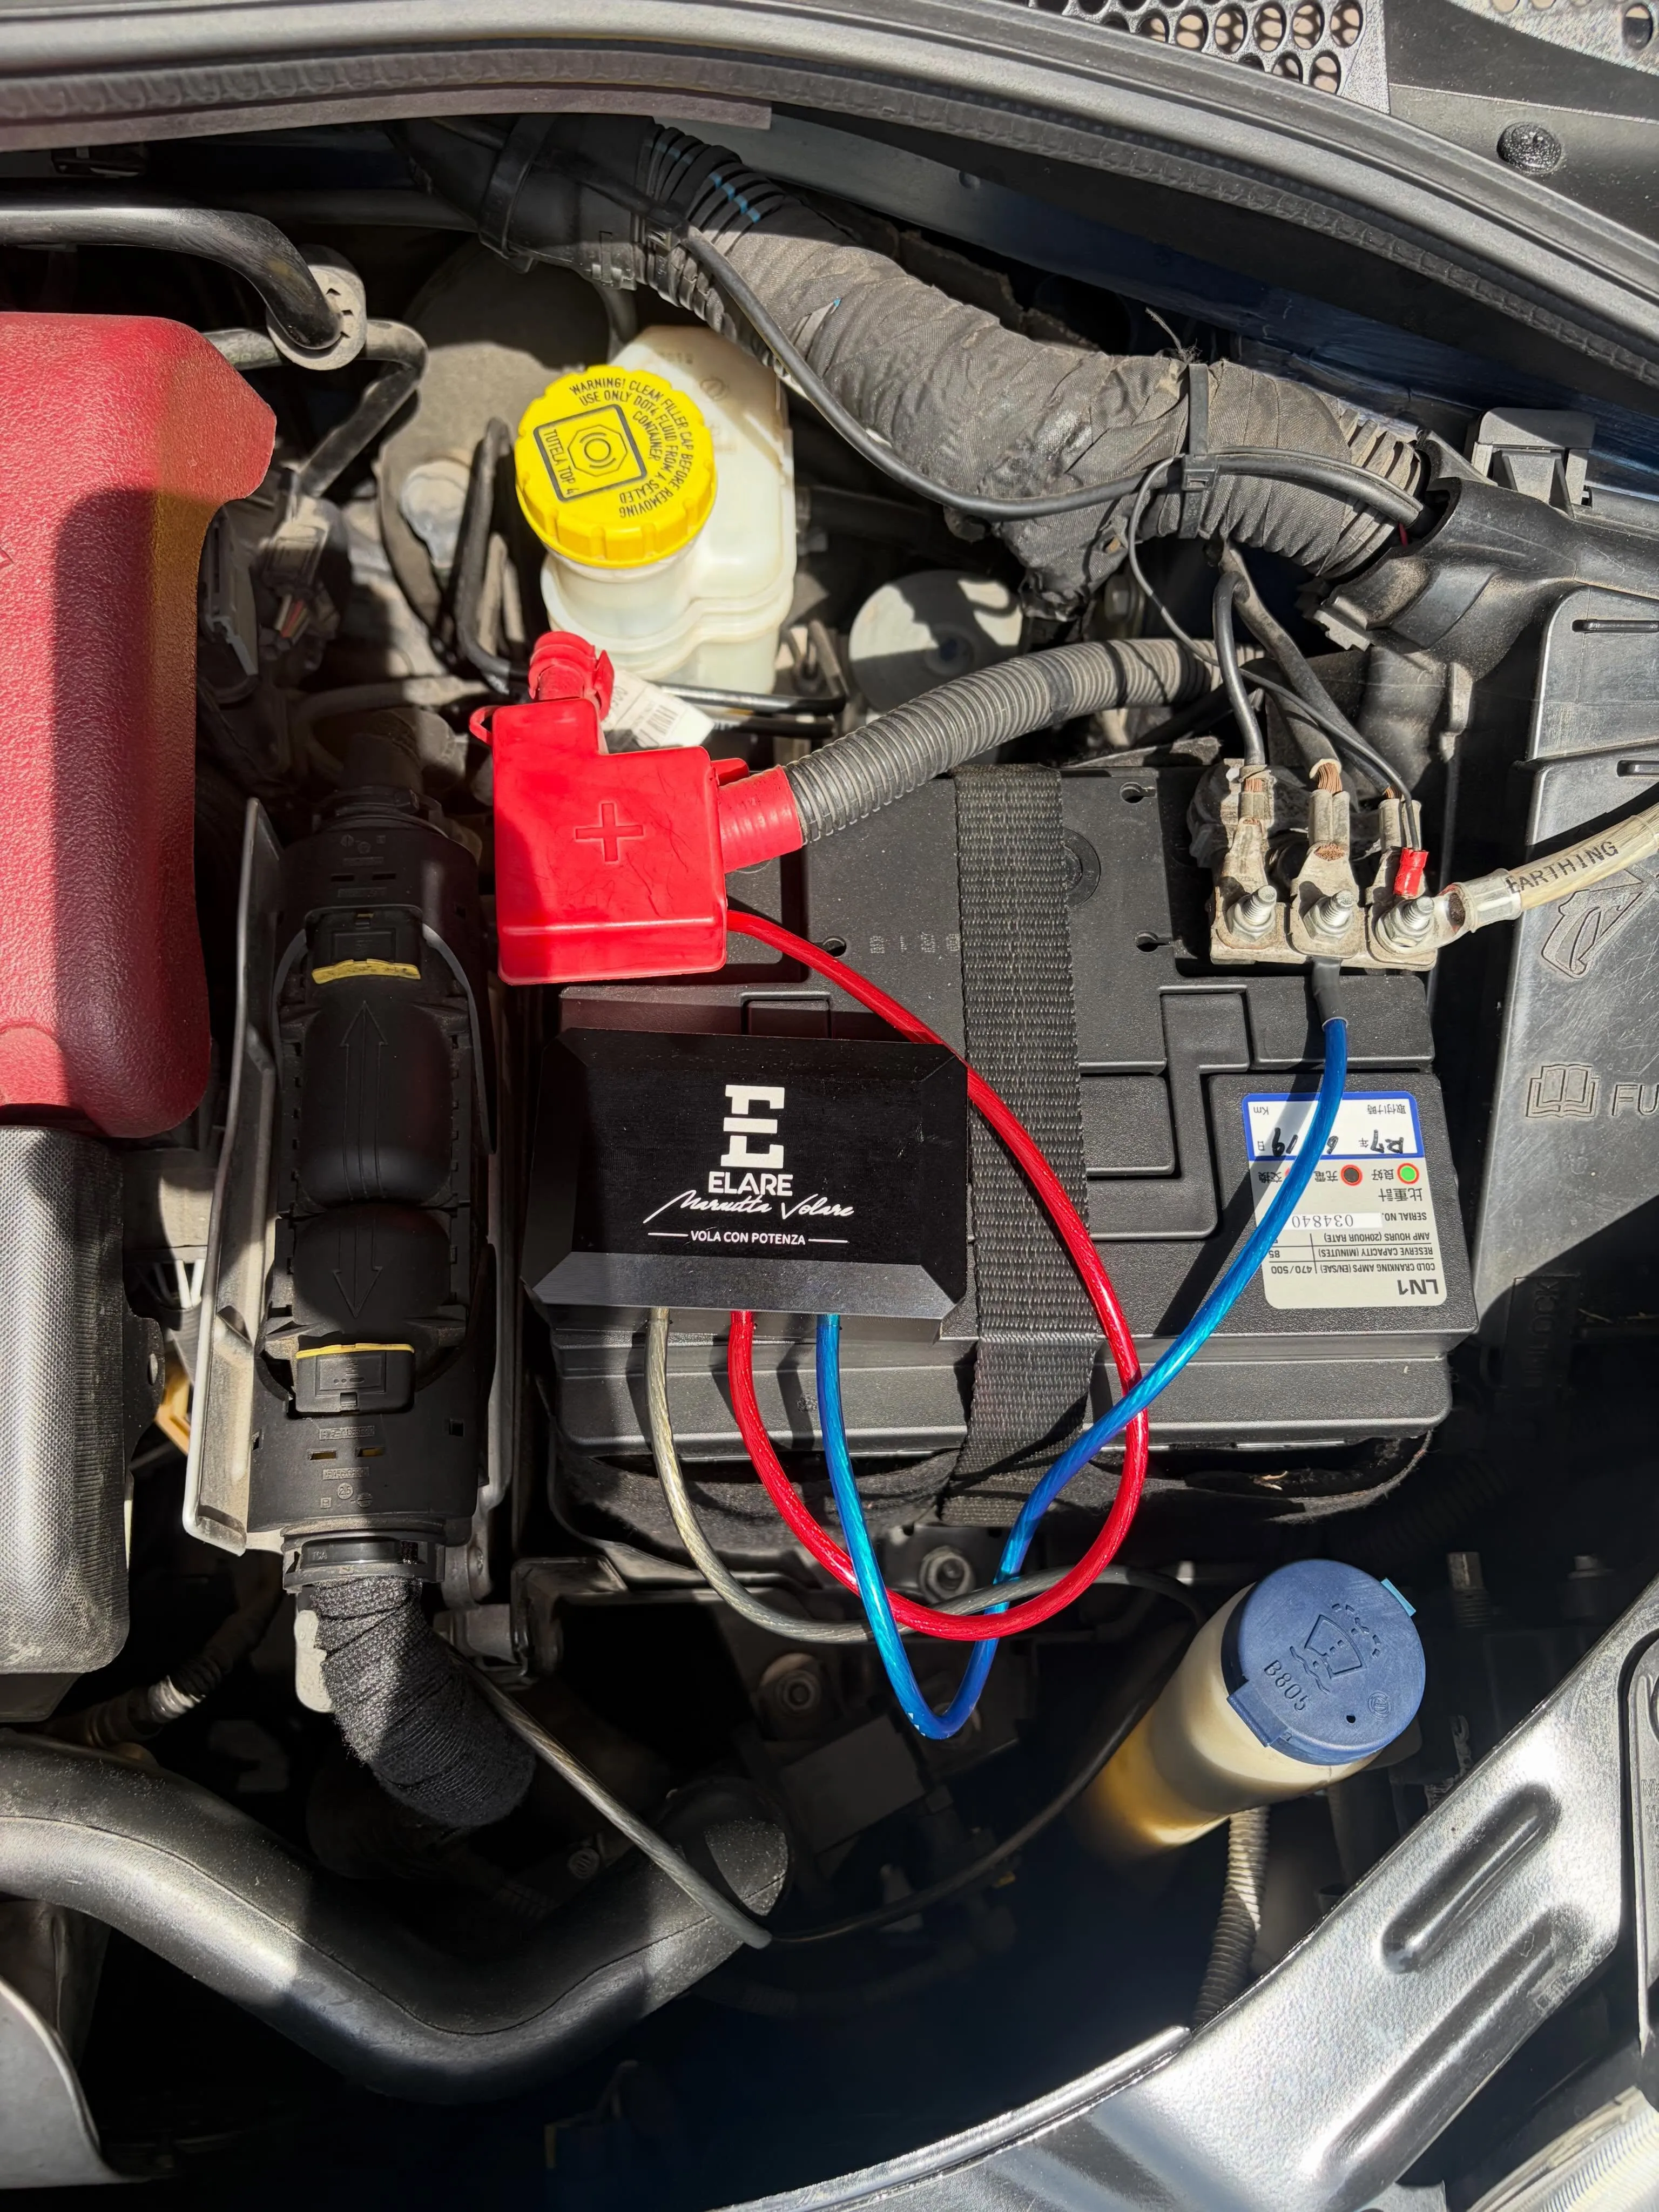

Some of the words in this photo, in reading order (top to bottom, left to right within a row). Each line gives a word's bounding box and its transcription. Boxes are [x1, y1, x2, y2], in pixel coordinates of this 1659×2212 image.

[569, 377, 626, 395] WARNING!
[629, 380, 664, 401] CLEAN
[579, 391, 601, 406] USE
[604, 390, 632, 402] ONLY
[661, 399, 689, 429] FILLER
[655, 414, 677, 441] FLUID
[632, 410, 662, 461] CONTAINER
[680, 431, 694, 450] CAP
[544, 429, 568, 466] TUTELA
[558, 466, 576, 483] TOP
[660, 445, 678, 473] FROM
[655, 471, 666, 481] A
[668, 453, 693, 490] BEFORE
[619, 480, 659, 503] SEALED
[619, 487, 674, 518] REMOVING
[1505, 841, 1619, 893] EARTHING
[1253, 1106, 1269, 1115] Km
[1367, 1104, 1406, 1115] 取付け時
[1258, 1171, 1282, 1184] 交換
[1314, 1170, 1338, 1182] 充電
[1371, 1169, 1394, 1181] 良好
[709, 1171, 793, 1196] ELARE
[1378, 1188, 1422, 1202] 比重計
[781, 1193, 854, 1219] Volare
[1292, 1214, 1353, 1228] 034840
[1381, 1213, 1400, 1221] NO.
[1401, 1212, 1427, 1220] SERIAL
[691, 1230, 721, 1242] VOLA
[723, 1231, 749, 1243] CON
[751, 1232, 806, 1245] POTENZA
[1324, 1233, 1346, 1242] RATE)
[1349, 1232, 1382, 1242] (20HOUR
[1385, 1233, 1410, 1241] HOURS
[1413, 1232, 1429, 1240] AMP
[1318, 1248, 1359, 1257] (MINUTES)
[1361, 1247, 1398, 1256] CAPACITY
[1400, 1247, 1433, 1255] RESERVE
[1271, 1265, 1312, 1274] 470/500
[1320, 1264, 1351, 1273] (EN/SAE)
[1353, 1264, 1374, 1272] AMPS
[1377, 1263, 1414, 1272] CRANKING
[1417, 1263, 1435, 1271] COLD
[1398, 1279, 1439, 1295] LN1
[1264, 1660, 1311, 1711] B805
